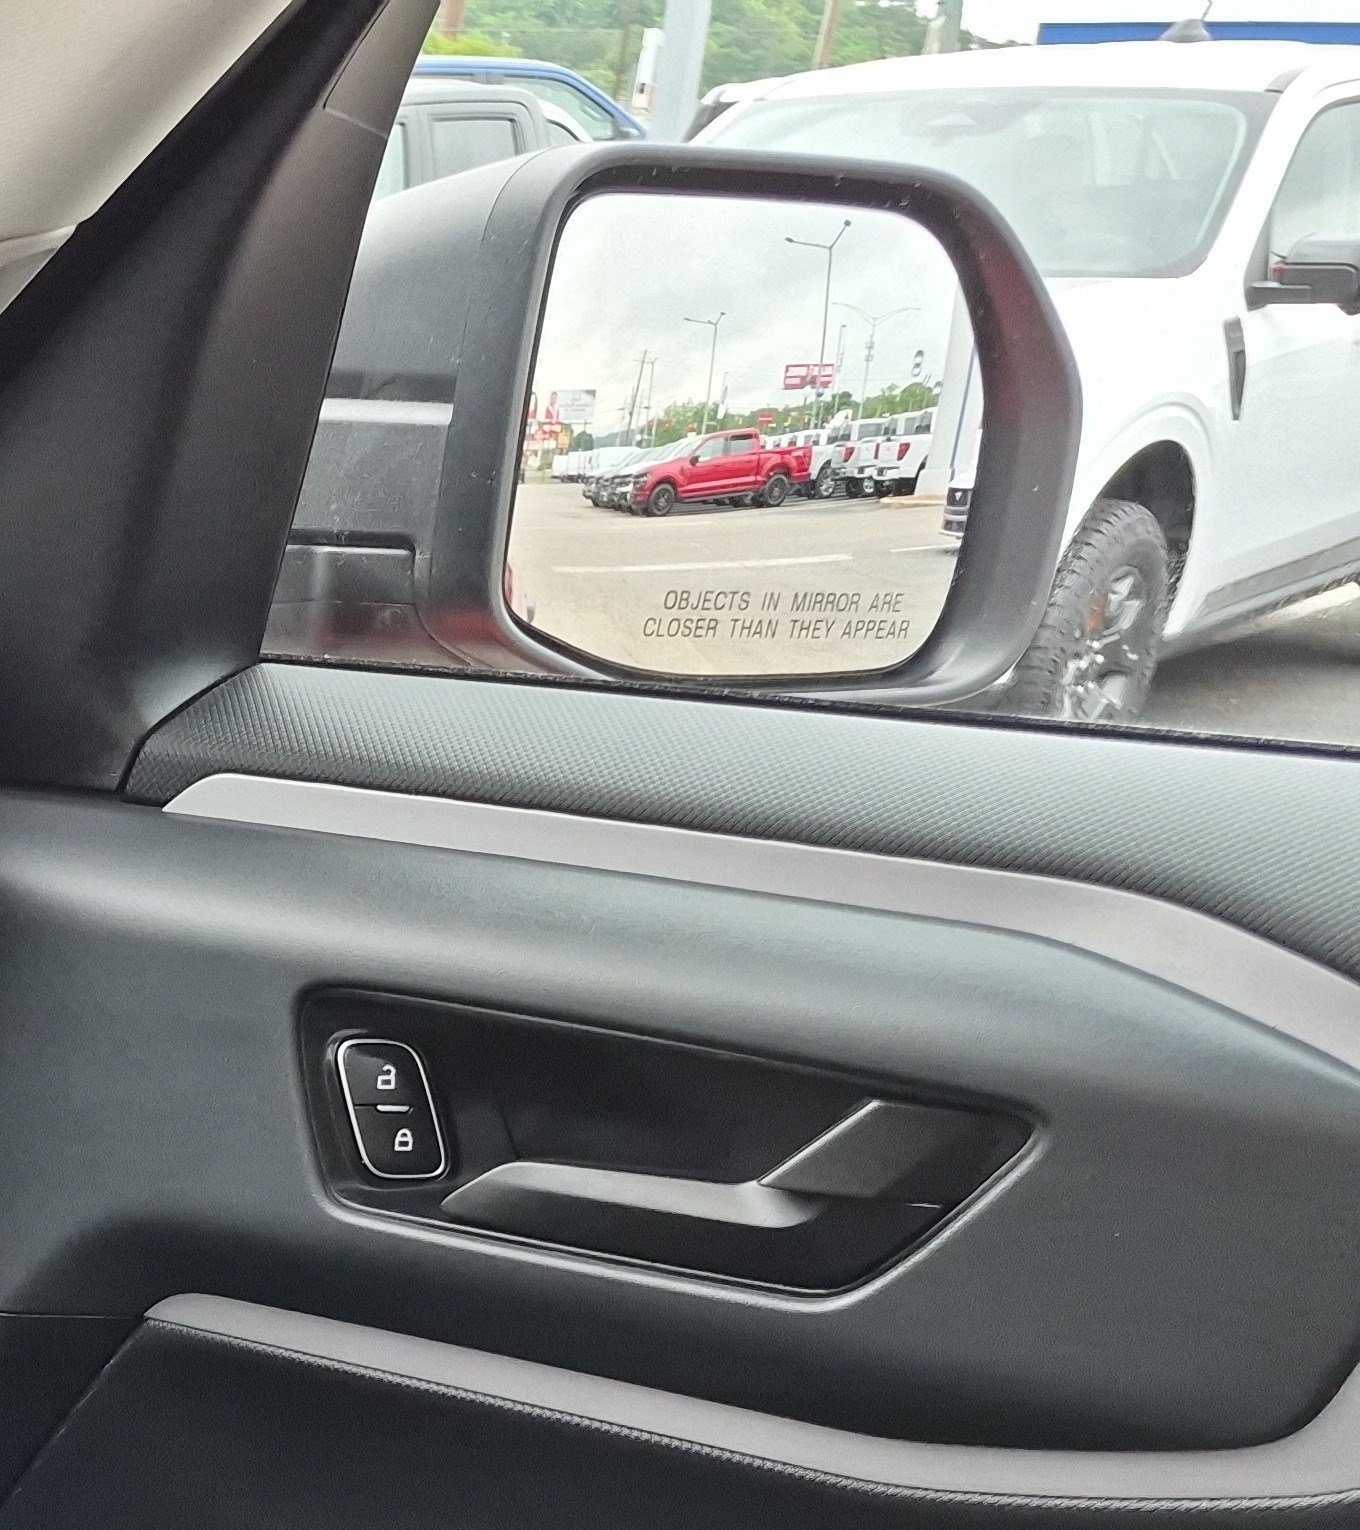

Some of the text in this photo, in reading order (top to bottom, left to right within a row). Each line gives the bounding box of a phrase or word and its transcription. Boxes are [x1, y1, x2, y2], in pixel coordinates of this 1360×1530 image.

[663, 590, 905, 613] OBJECTS IN MIRROR ARE
[643, 618, 910, 640] CLOSER THAN THEY APPEAR
